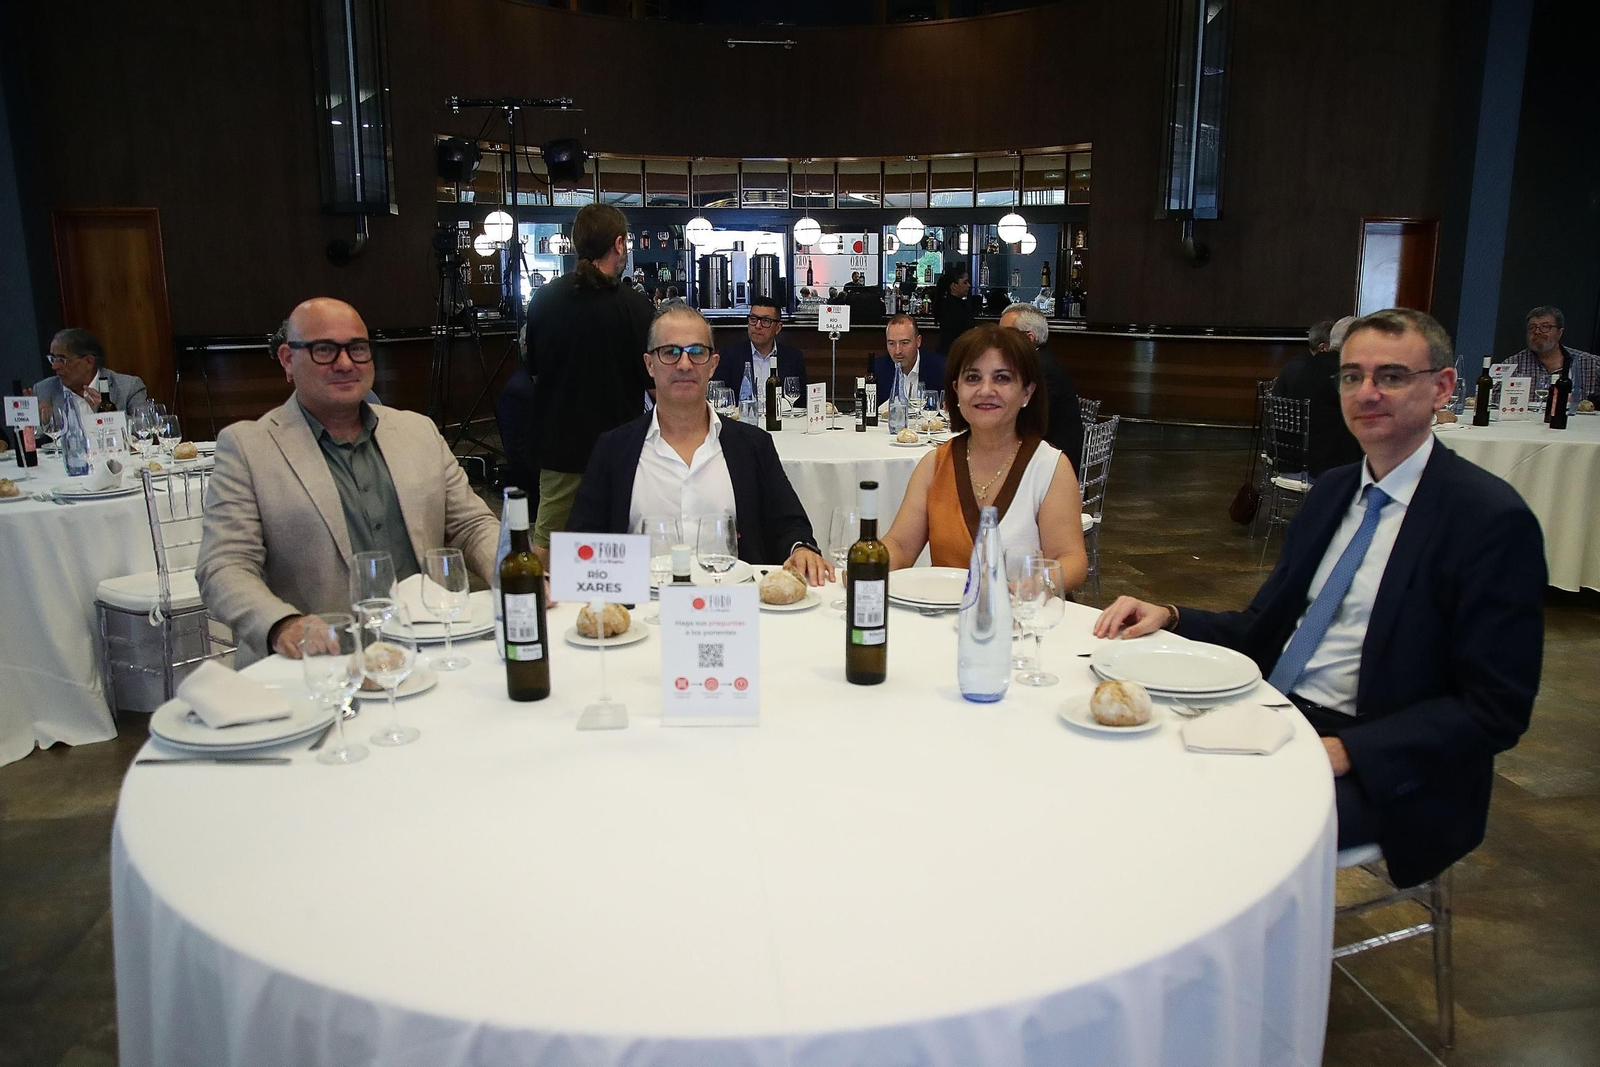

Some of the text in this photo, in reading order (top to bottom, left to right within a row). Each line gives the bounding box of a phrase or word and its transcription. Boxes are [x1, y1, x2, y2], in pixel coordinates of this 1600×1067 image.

[598, 542, 627, 558] FORO
[587, 569, 608, 580] RÍO
[576, 582, 622, 593] XARES
[709, 595, 732, 609] FORO
